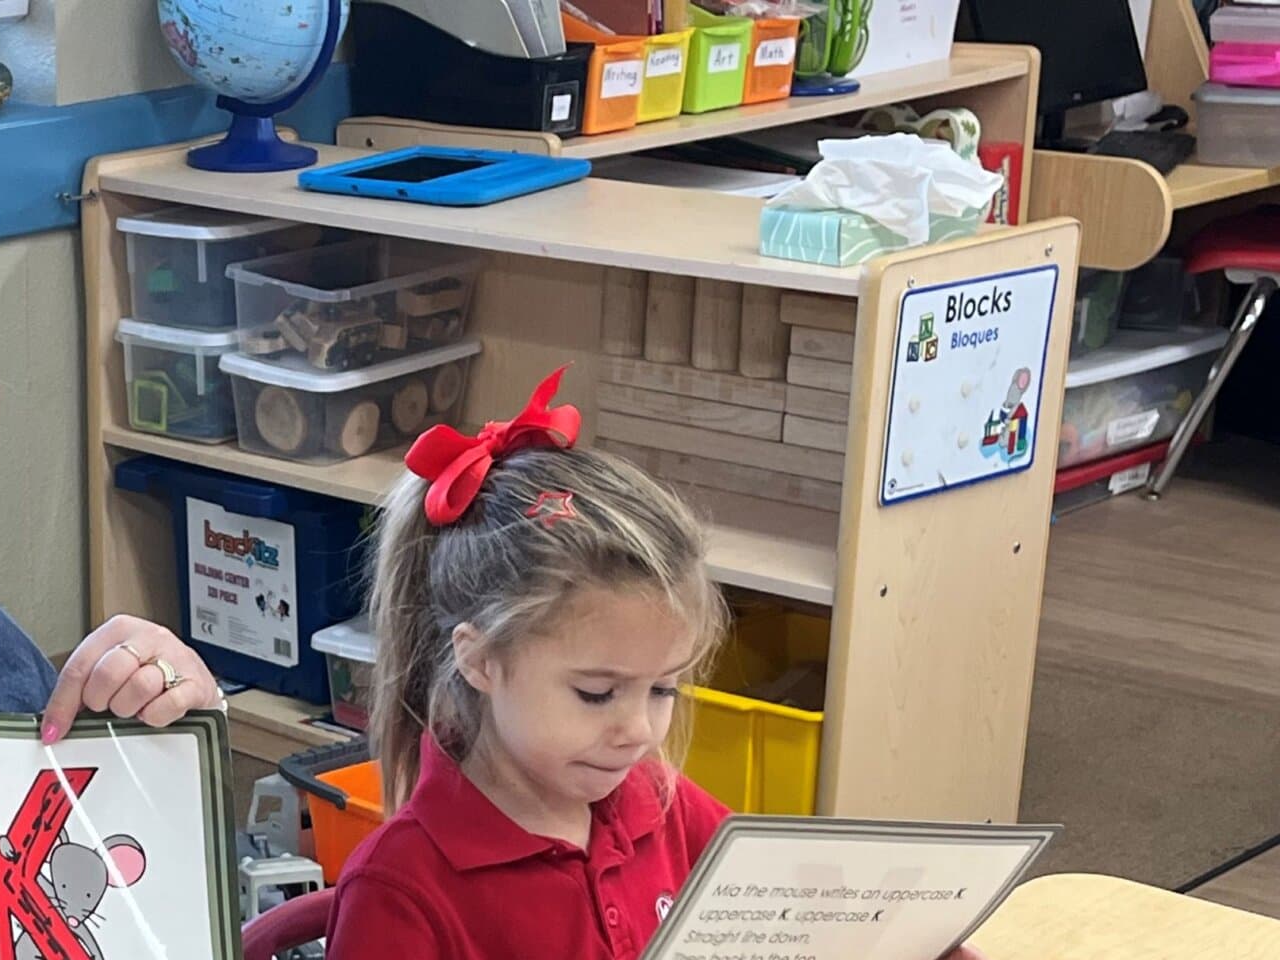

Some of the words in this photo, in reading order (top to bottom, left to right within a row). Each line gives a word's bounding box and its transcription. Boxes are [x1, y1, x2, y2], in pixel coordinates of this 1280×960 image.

[713, 50, 734, 67] Art
[759, 43, 785, 59] Math
[605, 66, 638, 87] Writing
[945, 285, 1012, 323] Blocks
[950, 326, 1000, 349] Bloques
[224, 571, 250, 589] CENTER
[711, 883, 742, 898] Mia
[743, 883, 769, 898] the
[770, 886, 819, 899] mouse
[820, 885, 860, 900] writes
[861, 888, 881, 900] an
[882, 888, 954, 904] uppercase
[698, 908, 777, 924] uppercase
[794, 909, 870, 926] uppercase
[683, 929, 742, 946] Straight
[740, 930, 767, 943] line
